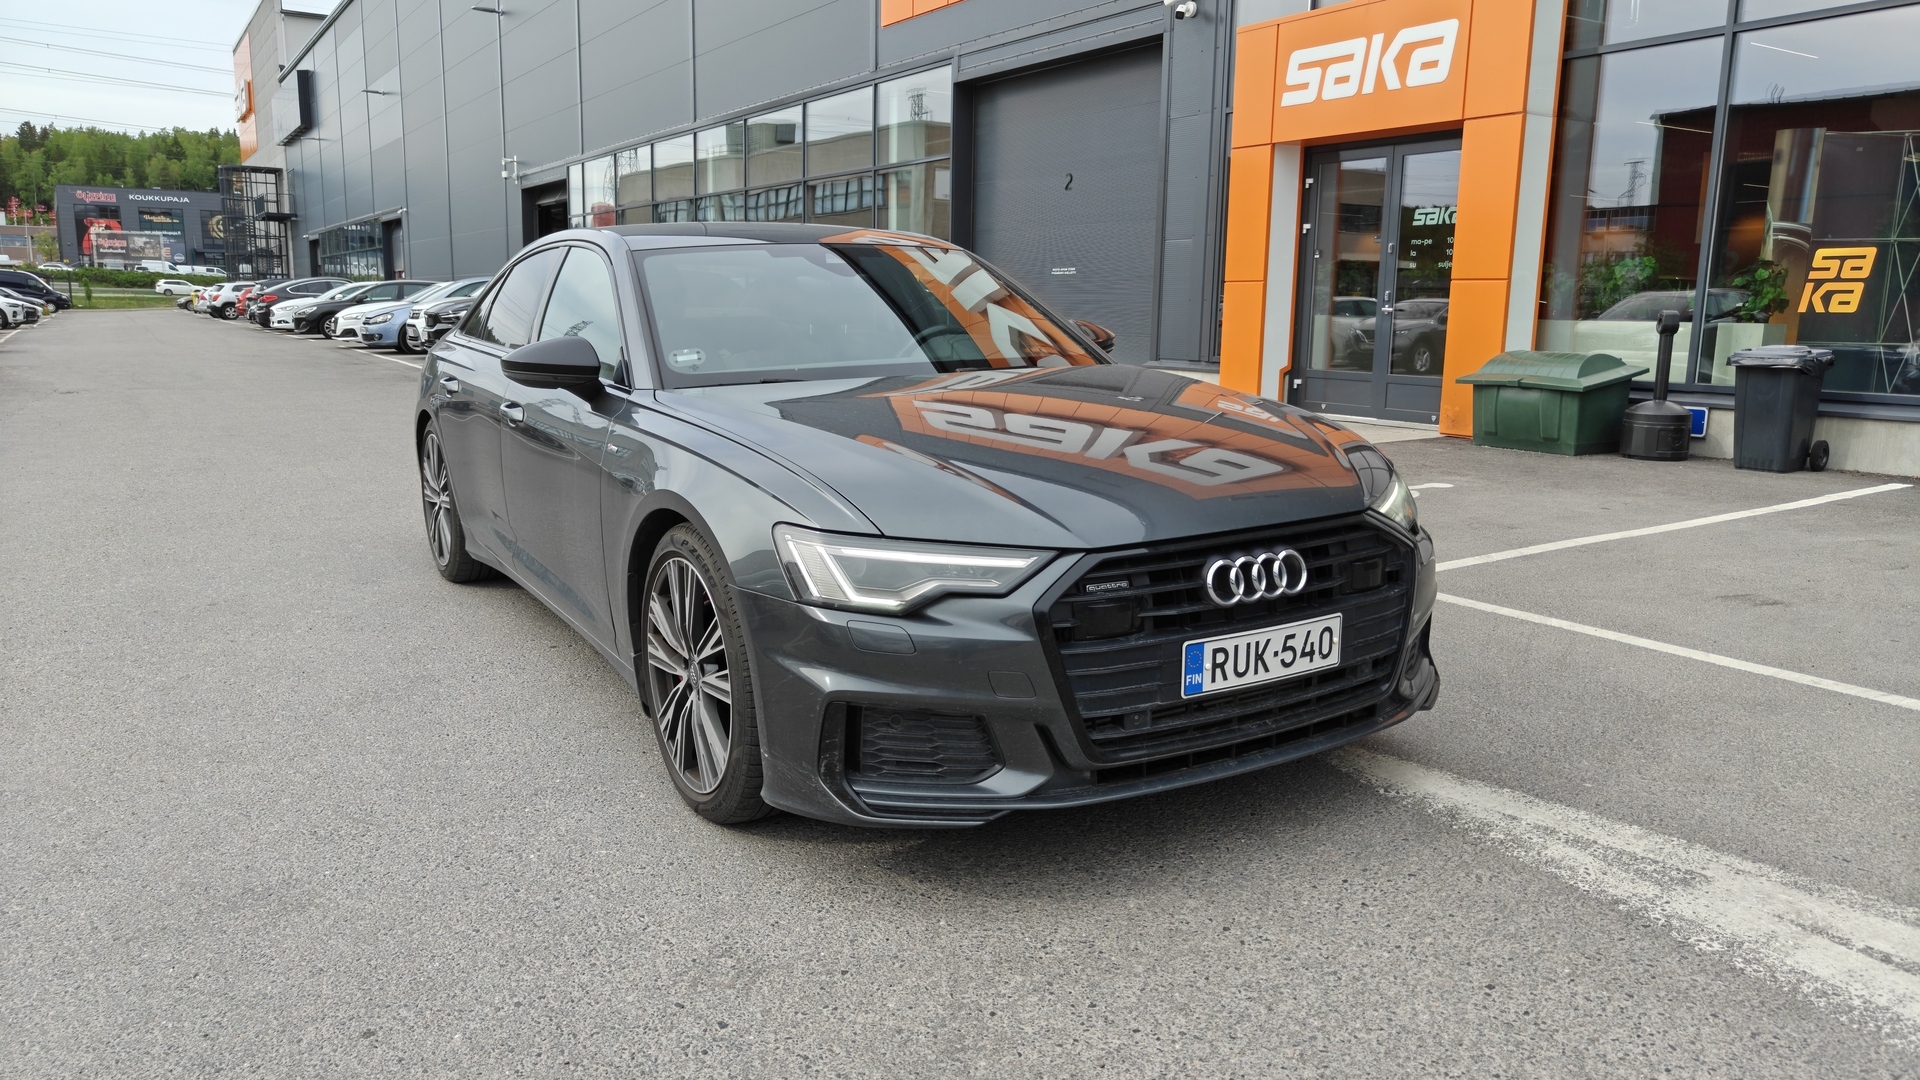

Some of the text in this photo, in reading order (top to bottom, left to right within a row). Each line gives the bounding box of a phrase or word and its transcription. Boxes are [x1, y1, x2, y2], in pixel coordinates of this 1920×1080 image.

[1064, 172, 1073, 191] 2
[128, 194, 190, 203] KOUKKUPAJA
[680, 539, 718, 589] P ZERO
[1088, 582, 1128, 592] quattro
[1186, 625, 1334, 687] FIN RUK-540
